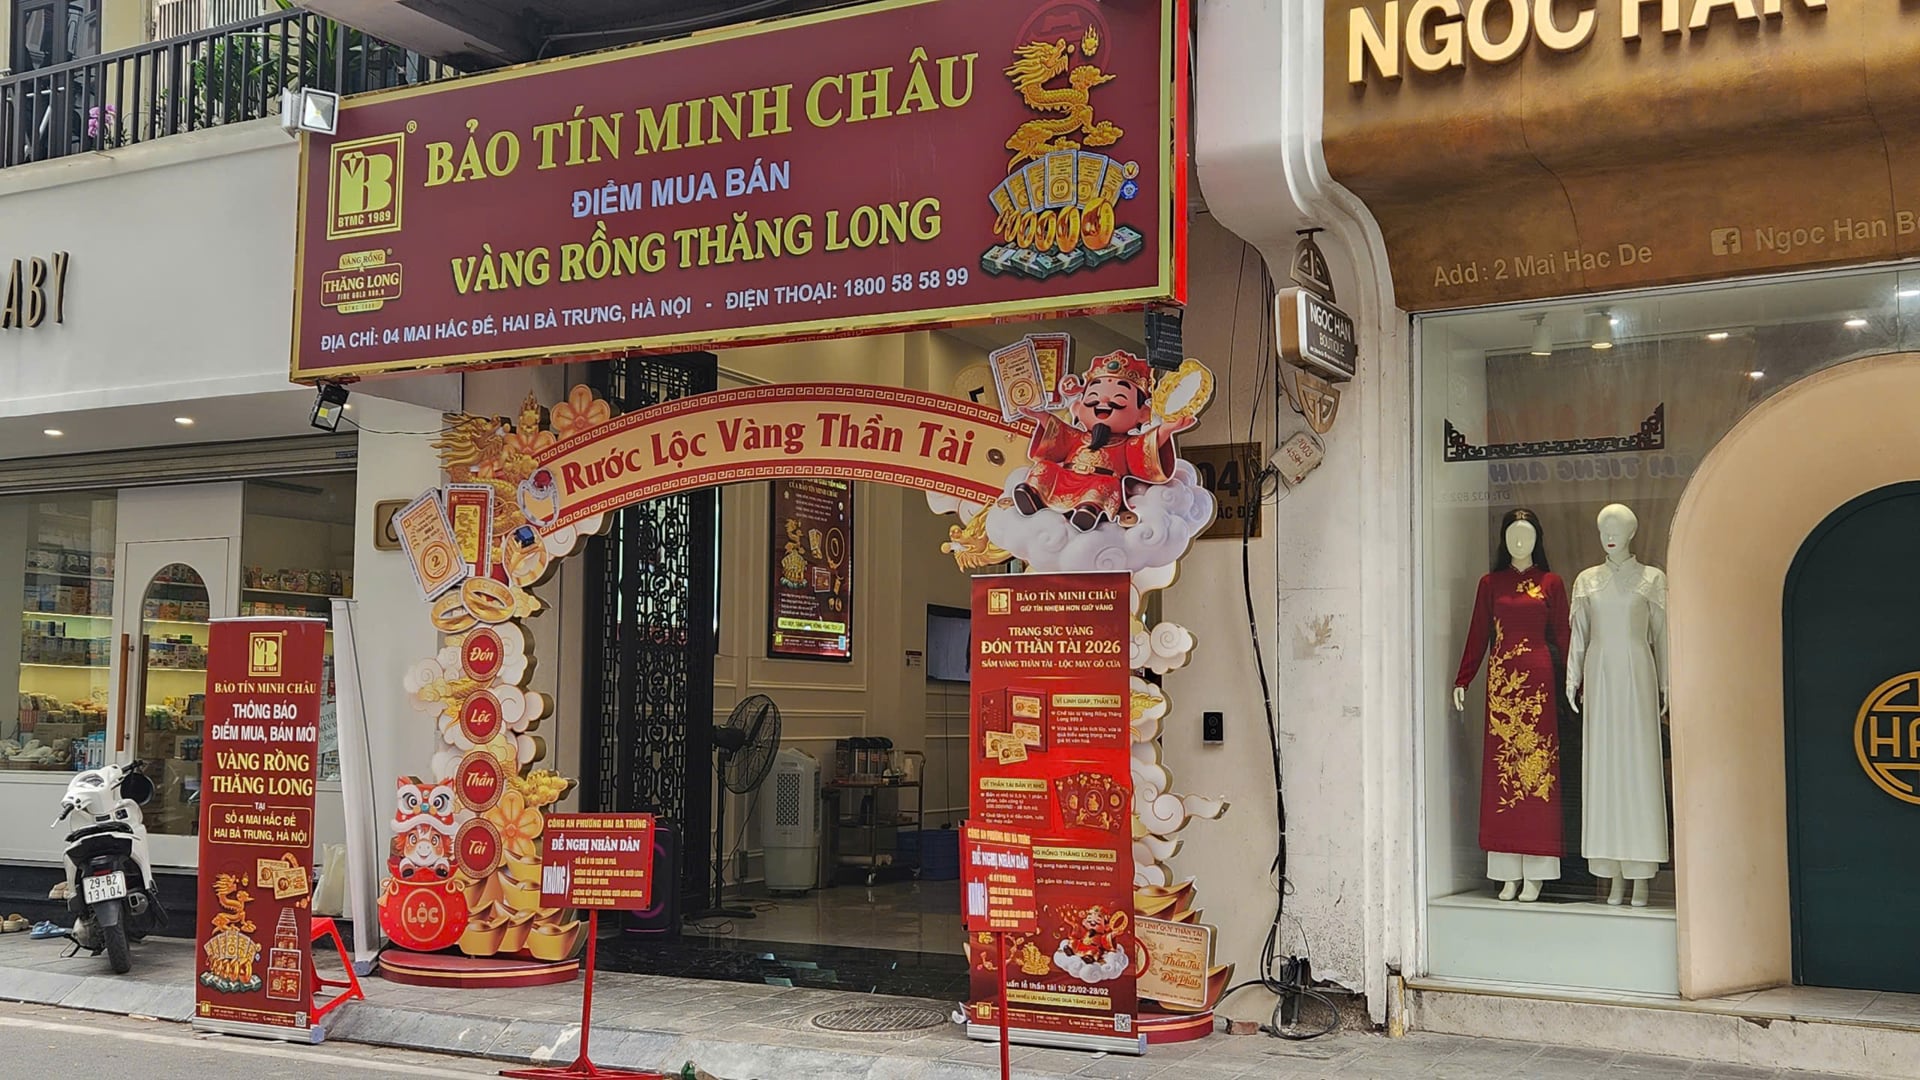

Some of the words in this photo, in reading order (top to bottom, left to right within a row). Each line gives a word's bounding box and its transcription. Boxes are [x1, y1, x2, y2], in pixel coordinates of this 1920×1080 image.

[1349, 0, 1597, 85] NGOC
[424, 119, 520, 187] BẢO
[532, 105, 624, 170] TÍN
[634, 83, 793, 155] MINH
[805, 46, 979, 128] CHÂU
[571, 178, 642, 218] ĐIỂM
[651, 172, 717, 208] MUA
[725, 157, 790, 198] BÁN
[338, 214, 364, 228] BTMC
[367, 210, 391, 224] 1989
[1755, 226, 1825, 255] Ngoc
[1833, 217, 1888, 243] Han
[1896, 210, 1920, 235] B
[451, 243, 550, 294] VÀNG
[559, 220, 666, 282] RỒNG
[673, 210, 813, 268] THĂNG
[825, 197, 941, 251] LONG
[341, 256, 361, 266] VÀNG
[1494, 258, 1509, 280] 2
[1514, 254, 1556, 278] Mai
[1563, 249, 1611, 273] Hac
[1618, 243, 1653, 266] De
[323, 276, 364, 293] THĂNG
[367, 272, 399, 288] LONG
[321, 334, 345, 353] ĐỊA
[349, 327, 379, 348] CHỈ:
[383, 328, 400, 345] 04
[403, 324, 431, 342] MAI
[502, 314, 530, 332] HAI
[534, 307, 557, 329] BÀ
[561, 304, 626, 327] TRƯNG,
[631, 297, 656, 320] HÀ
[660, 295, 692, 319] NỘI
[725, 287, 769, 312] ĐIỆN
[774, 281, 838, 305] THOẠI:
[843, 276, 886, 297] 1800
[891, 273, 913, 293] 58
[918, 270, 941, 290] 58
[945, 267, 969, 287] 99
[560, 445, 642, 496] Rước
[651, 430, 707, 469] Lộc
[716, 418, 806, 454] Vàng
[816, 413, 903, 452] Thần
[918, 421, 975, 467] Tài
[1016, 590, 1037, 602] BẢO
[1039, 589, 1056, 601] TÍN
[1058, 591, 1086, 601] MINH
[1088, 588, 1117, 601] CHÂU
[1095, 603, 1114, 611] VÀNG
[1008, 627, 1041, 637] TRANG
[1042, 625, 1063, 636] SỨC
[1065, 624, 1094, 636] VÀNG
[469, 646, 494, 662] Đón
[981, 637, 1012, 654] ĐÓN
[1015, 636, 1054, 654] THẦN
[1057, 638, 1081, 654] TÀI
[1085, 640, 1121, 654] 2026
[214, 680, 235, 693] BẢO
[237, 680, 255, 694] TÍN
[257, 682, 285, 694] MINH
[287, 680, 317, 694] CHÂU
[232, 699, 271, 719] THÔNG
[273, 699, 297, 719] BÁO
[470, 708, 491, 727] Lộc
[211, 718, 239, 740] ĐIỂM
[241, 725, 268, 744] MUA,
[270, 721, 293, 742] BÁN
[296, 722, 316, 742] MỚI
[216, 748, 260, 771] VÀNG
[263, 748, 310, 772] RỒNG
[210, 772, 264, 794] THĂNG
[268, 777, 313, 796] LONG
[465, 772, 495, 788] Thần
[254, 801, 266, 812] TẠI
[224, 809, 238, 824] SỐ
[238, 814, 244, 824] 4
[245, 814, 261, 825] MAI
[262, 811, 282, 825] HẮC
[283, 811, 297, 827] ĐẾ
[566, 818, 575, 828] AN
[602, 818, 614, 828] HAI
[213, 828, 228, 838] HAI
[229, 826, 241, 838] BÀ
[276, 828, 290, 841] HÀ
[291, 829, 307, 844] NỘI
[469, 839, 487, 856] Tài
[566, 838, 589, 854] NGHỊ
[591, 835, 618, 851] NHÂN
[620, 835, 640, 852] DÂN
[89, 874, 118, 890] 29-B2
[88, 886, 122, 901] 131.04
[407, 903, 439, 928] LỘC
